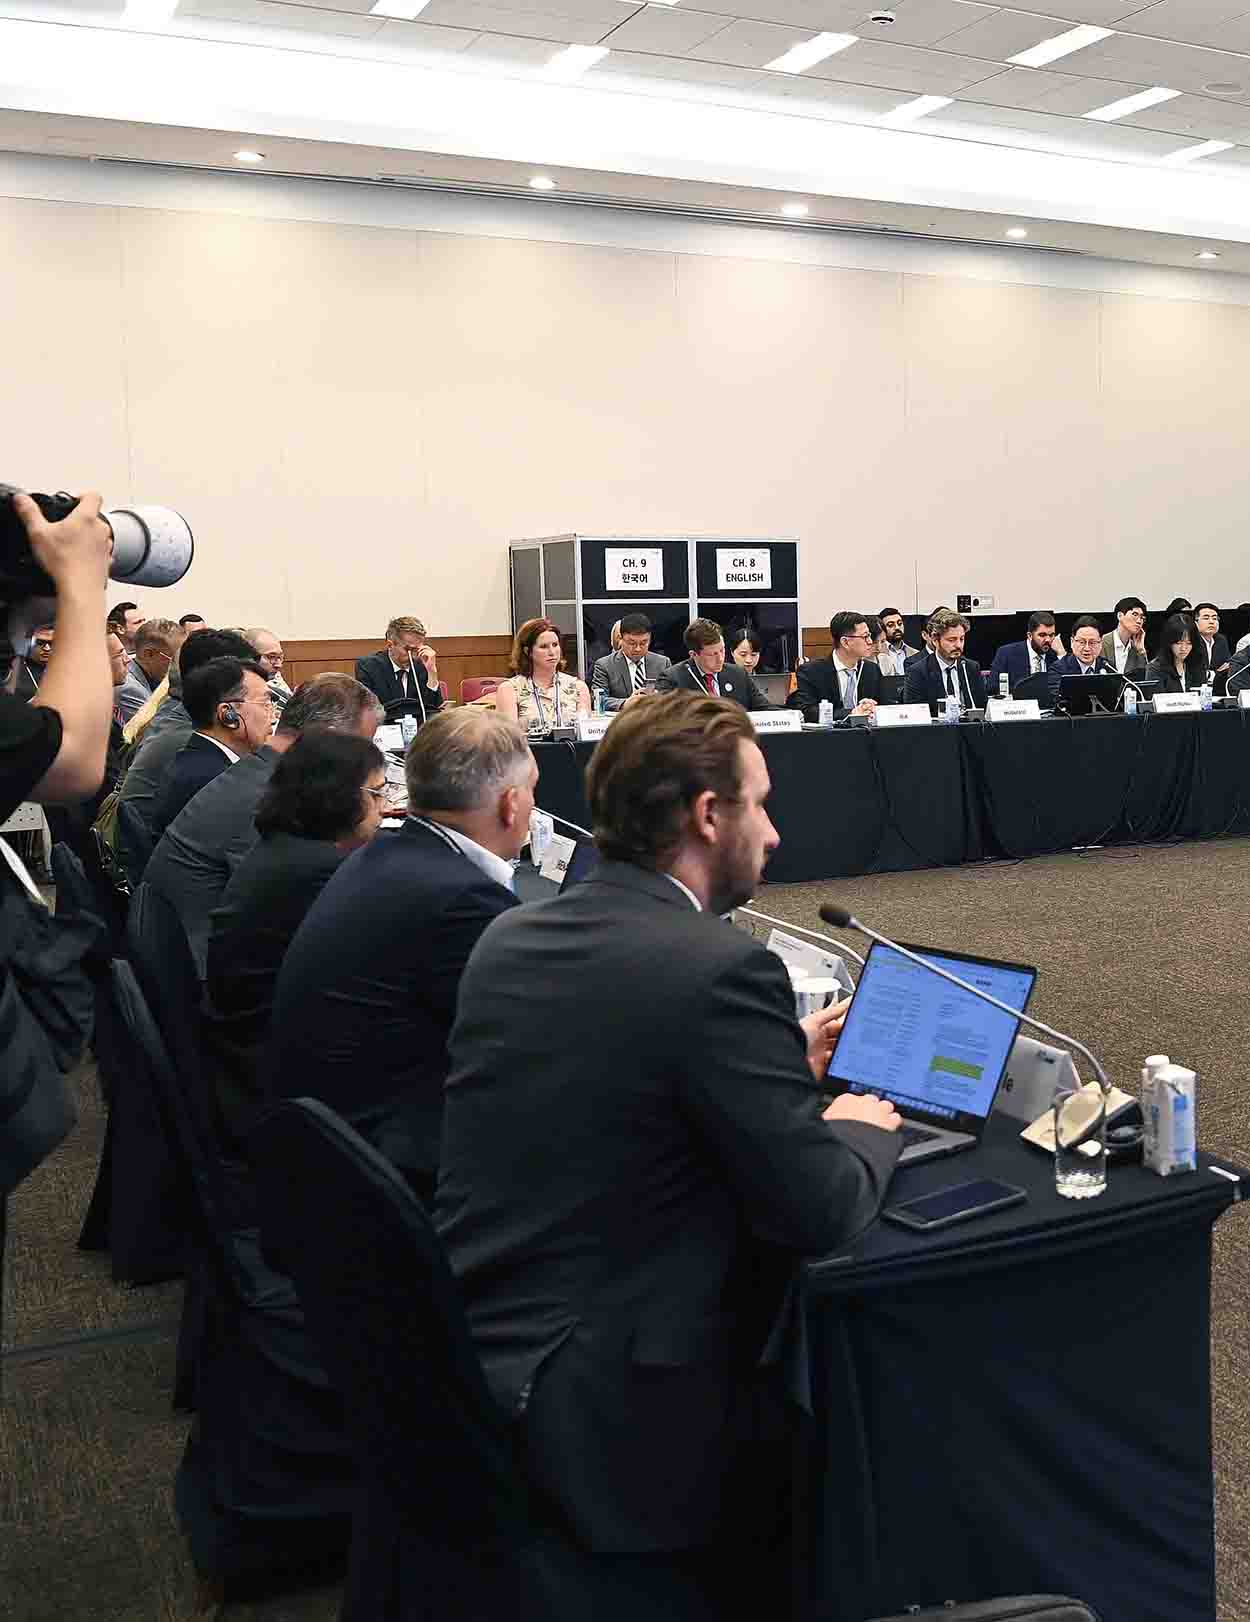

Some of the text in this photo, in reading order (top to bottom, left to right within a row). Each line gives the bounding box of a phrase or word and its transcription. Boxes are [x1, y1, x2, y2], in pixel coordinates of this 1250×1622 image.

[622, 558, 647, 568] CH. 9
[732, 558, 756, 568] CH. 8
[622, 573, 648, 584] 한국어
[726, 573, 764, 582] ENGLISH
